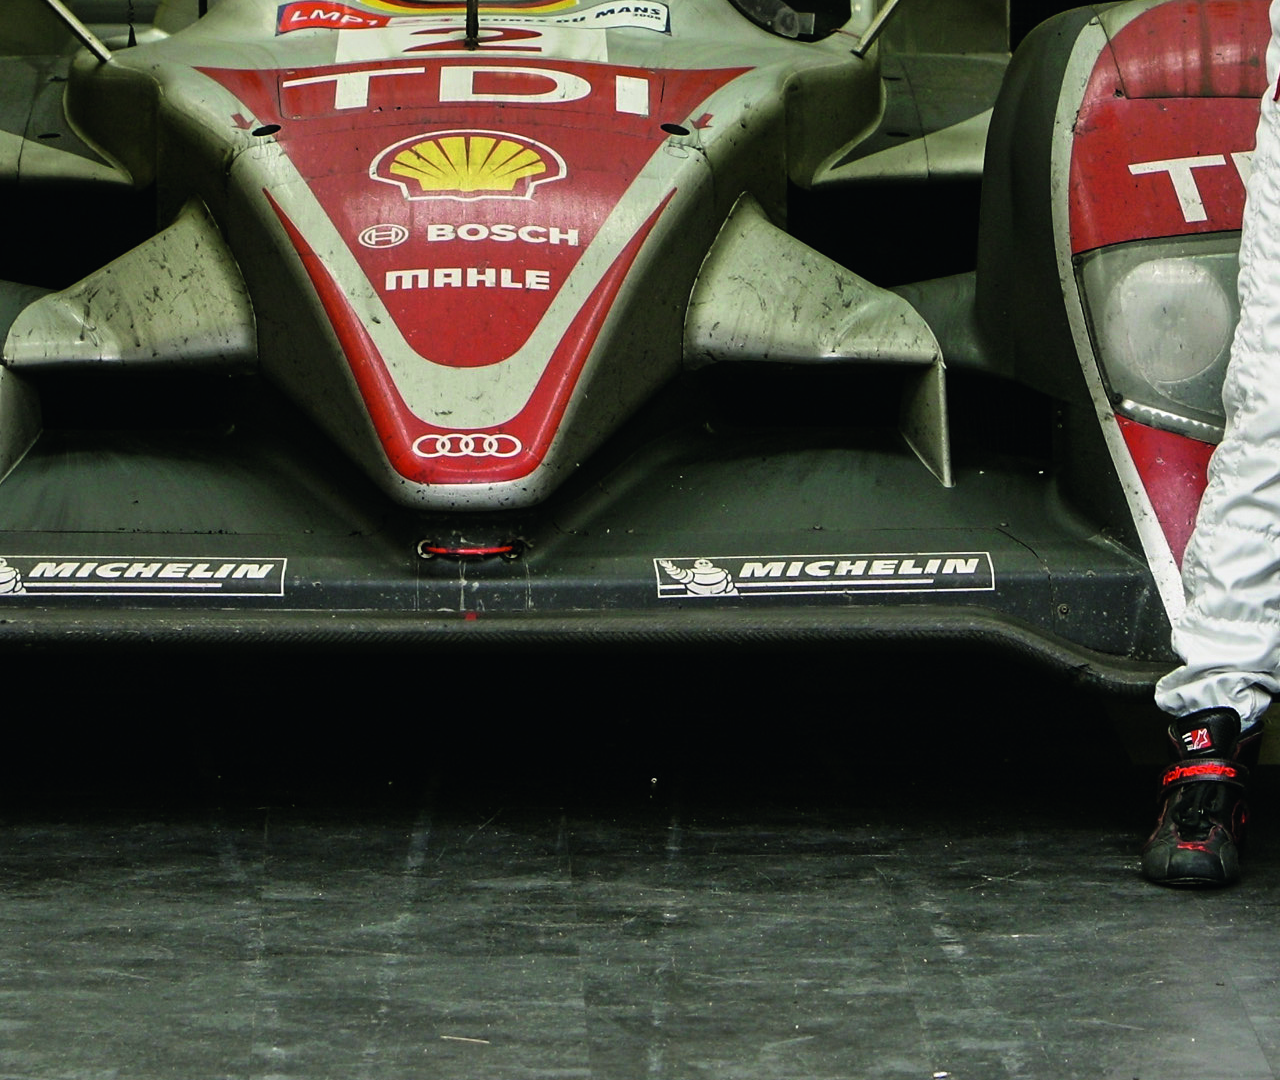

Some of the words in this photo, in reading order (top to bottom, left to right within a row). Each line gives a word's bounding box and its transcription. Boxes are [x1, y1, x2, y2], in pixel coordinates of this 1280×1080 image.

[290, 9, 379, 26] LMP1
[595, 6, 661, 19] MANS
[402, 27, 544, 52] 2
[282, 66, 650, 116] TDI
[427, 223, 579, 247] BOSCH
[385, 267, 551, 291] MAHLE
[28, 562, 274, 579] MICHELIN
[738, 558, 980, 578] MICHELIN
